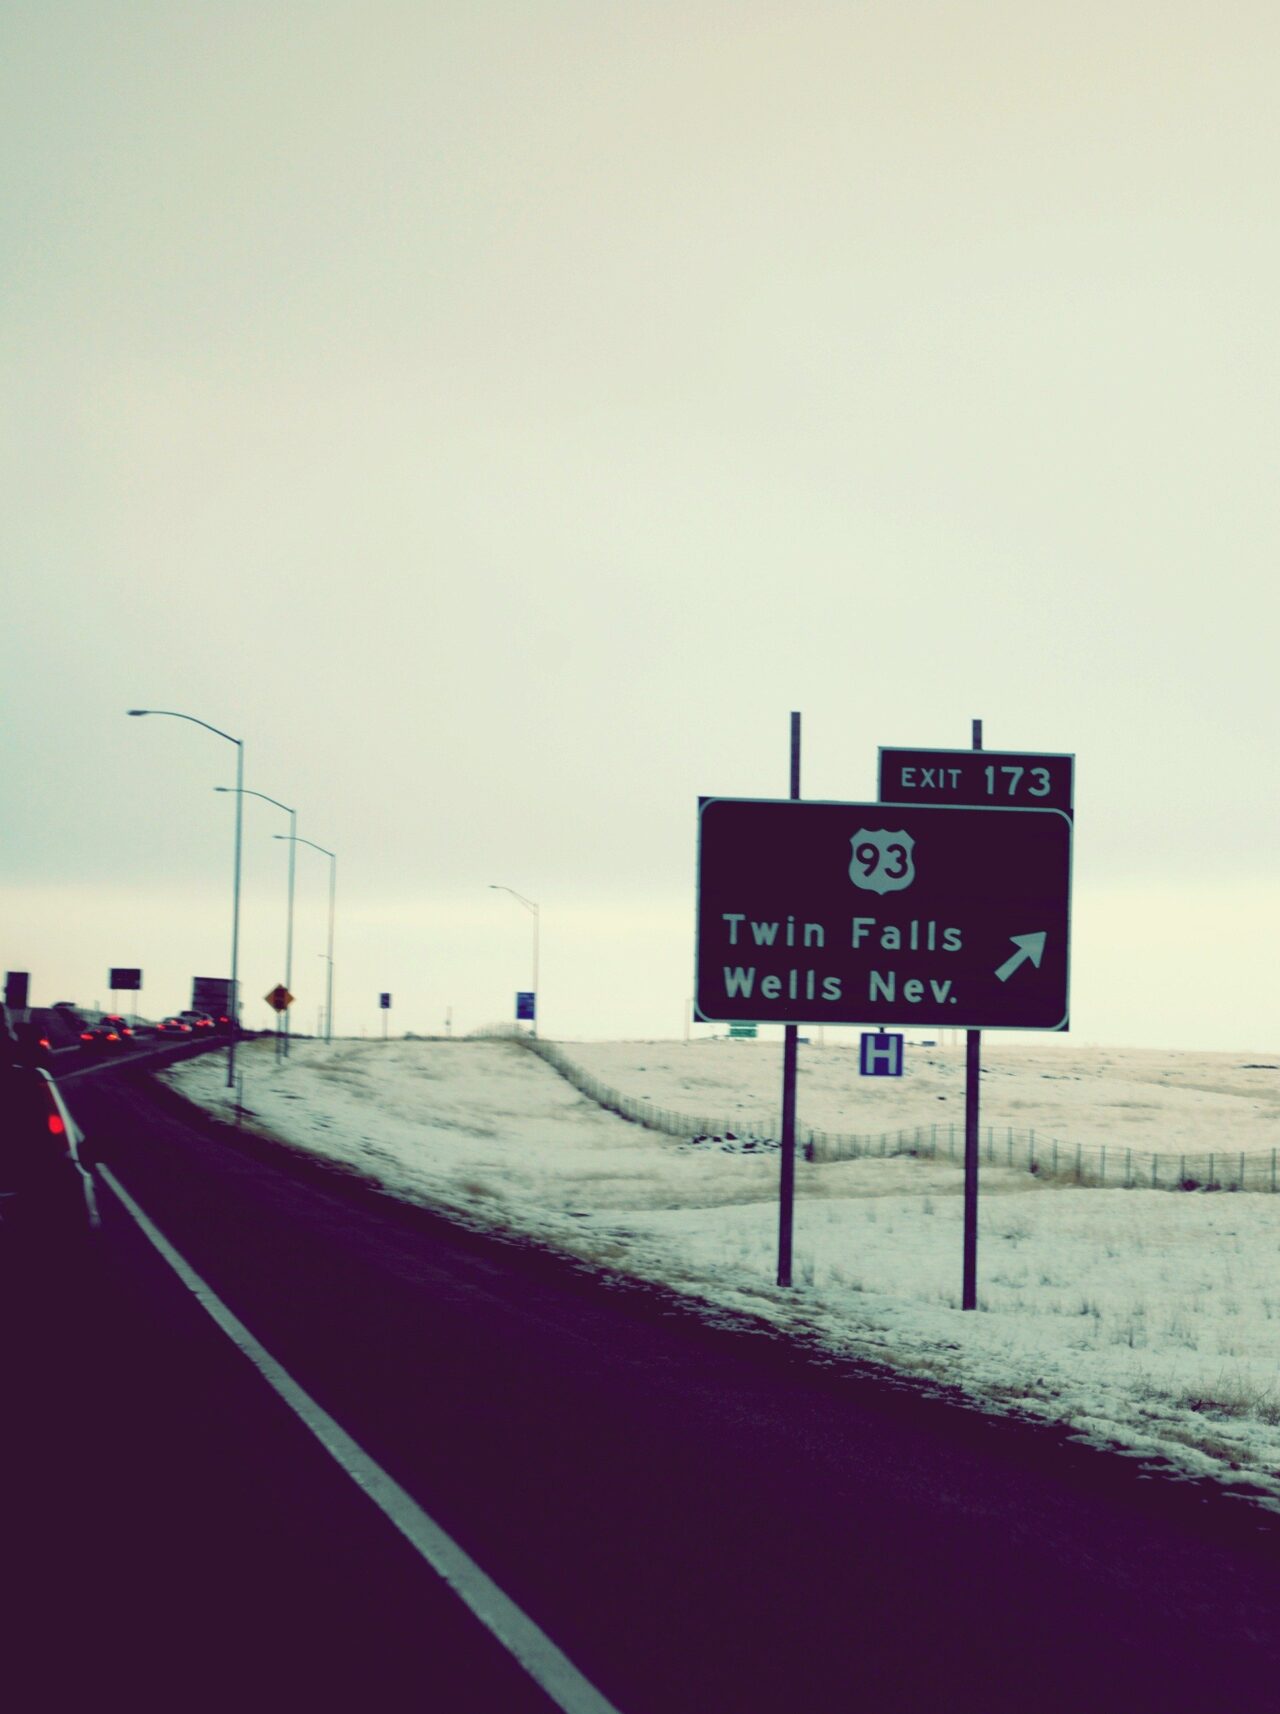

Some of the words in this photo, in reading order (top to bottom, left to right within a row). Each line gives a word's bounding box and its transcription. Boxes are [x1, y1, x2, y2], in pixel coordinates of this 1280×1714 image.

[901, 767, 962, 789] EXIT
[984, 766, 1051, 796] 173
[855, 842, 908, 879] 93
[722, 913, 825, 948] Twin
[852, 917, 963, 952] Falls
[723, 966, 842, 1001] Wells
[869, 970, 958, 1004] Nev.
[865, 1036, 897, 1075] H
